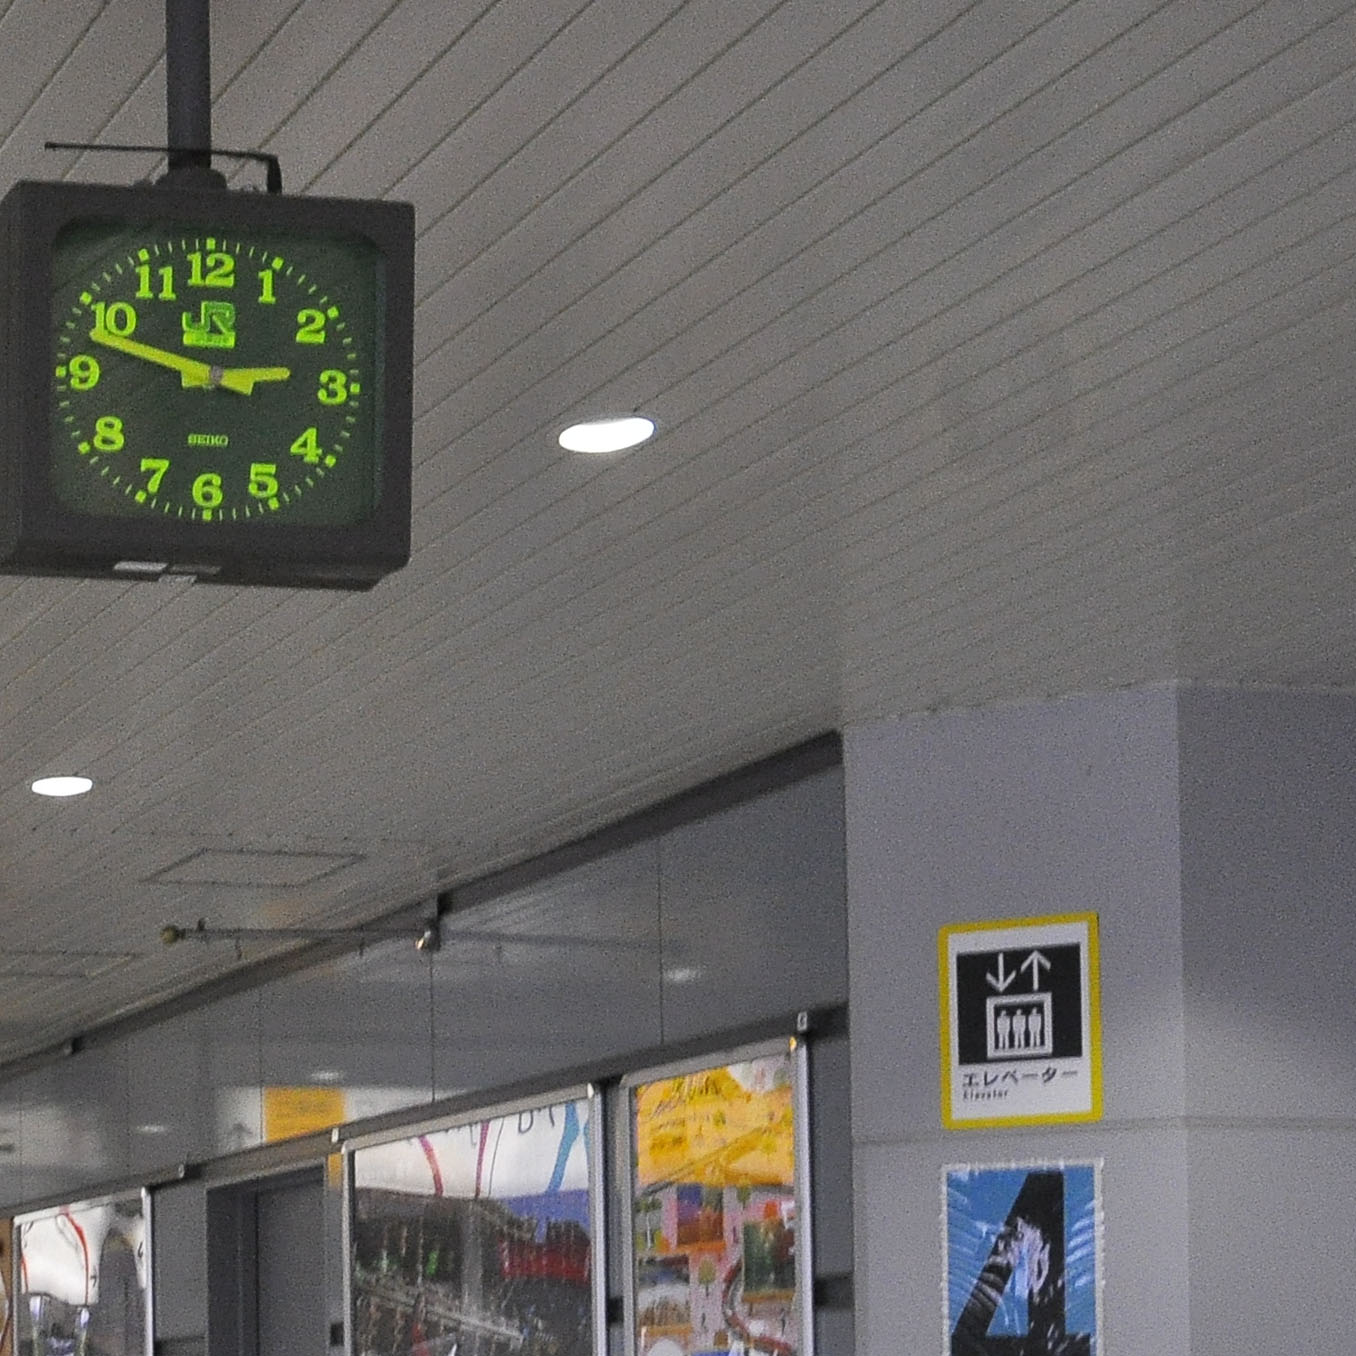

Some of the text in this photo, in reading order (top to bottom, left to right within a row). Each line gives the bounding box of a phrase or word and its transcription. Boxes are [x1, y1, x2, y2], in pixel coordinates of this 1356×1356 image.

[135, 265, 176, 300] 11
[187, 252, 235, 288] 12
[258, 268, 276, 304] 1
[91, 301, 137, 338] 10
[295, 309, 326, 344] 2
[68, 355, 100, 390] 9
[317, 370, 348, 405] 3
[93, 416, 125, 452] 8
[188, 434, 229, 447] SEIKO
[290, 427, 322, 464] 4
[140, 459, 170, 494] 7
[192, 473, 223, 508] 6
[248, 463, 279, 498] 5
[962, 1066, 1079, 1088] エレベーター
[962, 1088, 1010, 1101] Elevator
